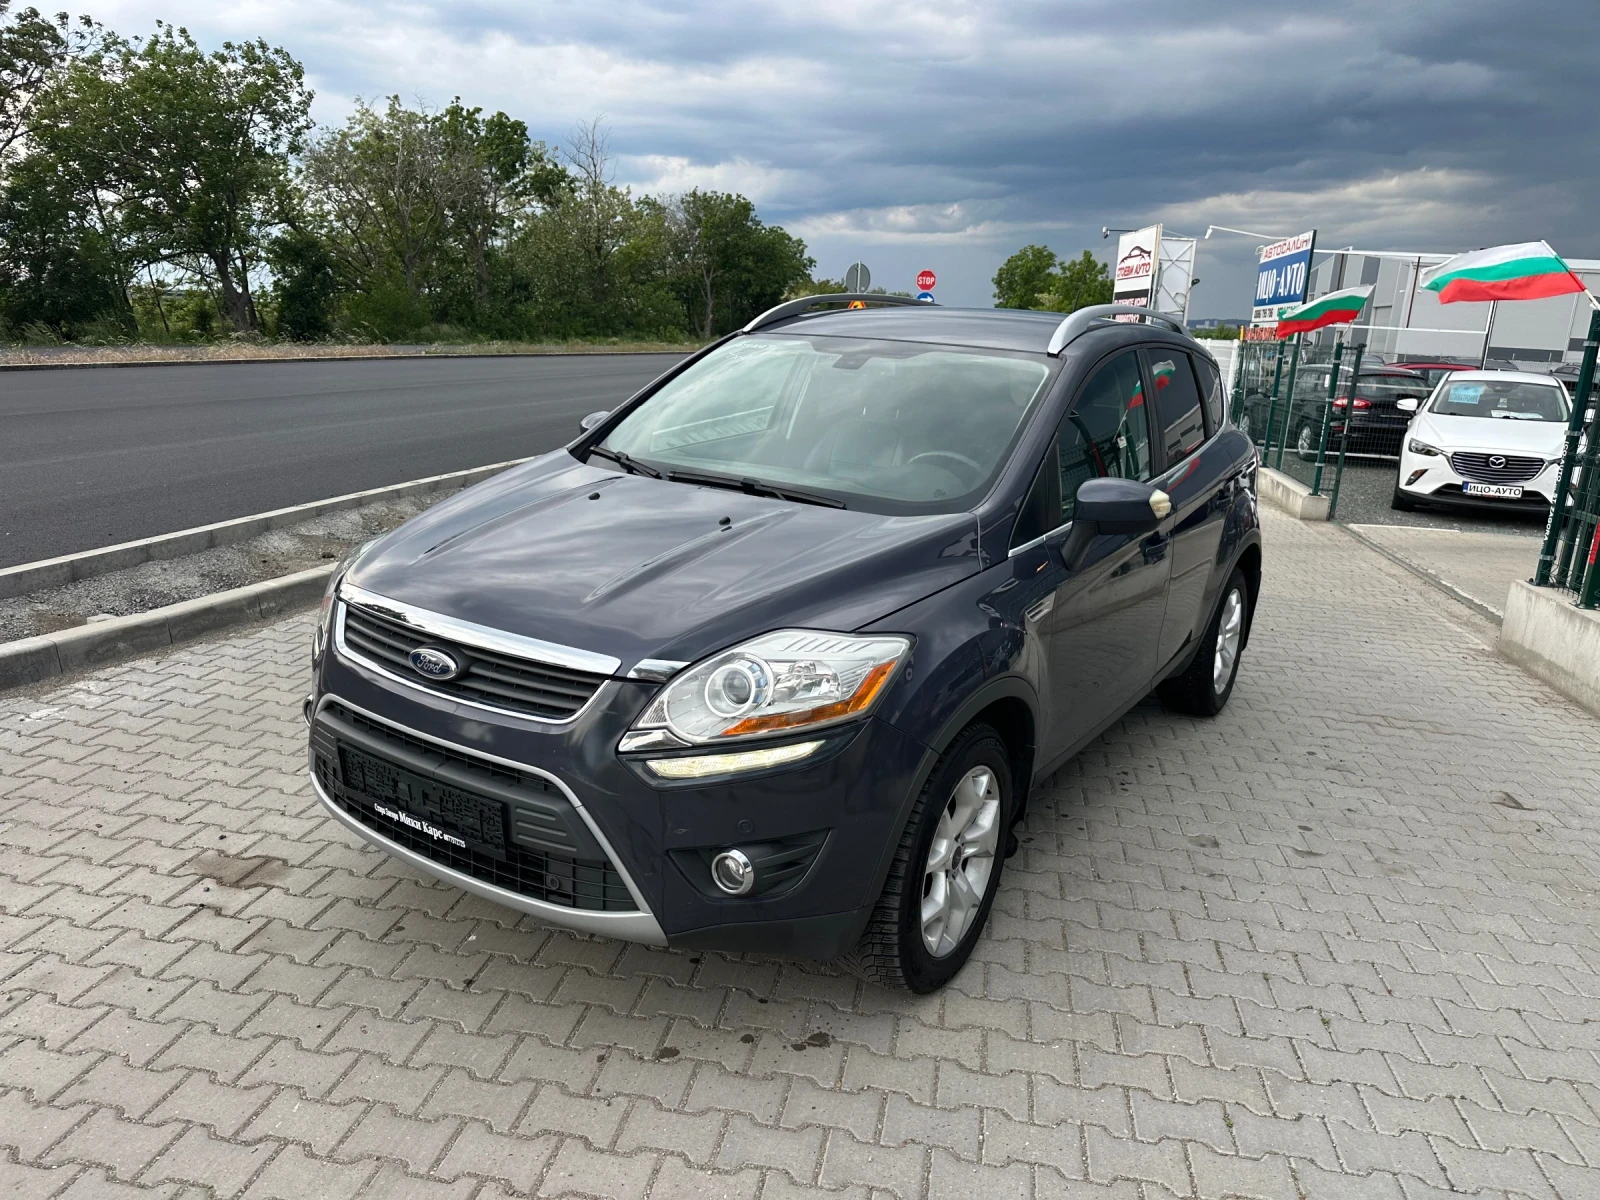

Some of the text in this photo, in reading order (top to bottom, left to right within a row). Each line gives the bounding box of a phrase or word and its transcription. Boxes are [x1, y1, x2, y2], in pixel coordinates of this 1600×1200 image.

[1134, 262, 1151, 275] АУТО
[918, 276, 935, 285] STOP
[1256, 261, 1306, 303] ИЦО-АУТО
[1469, 484, 1521, 496] ИЦО-АУТО
[1543, 505, 1554, 541] ZAGORA
[416, 653, 443, 674] Ford
[398, 811, 422, 831] Мики
[422, 821, 444, 840] Карс
